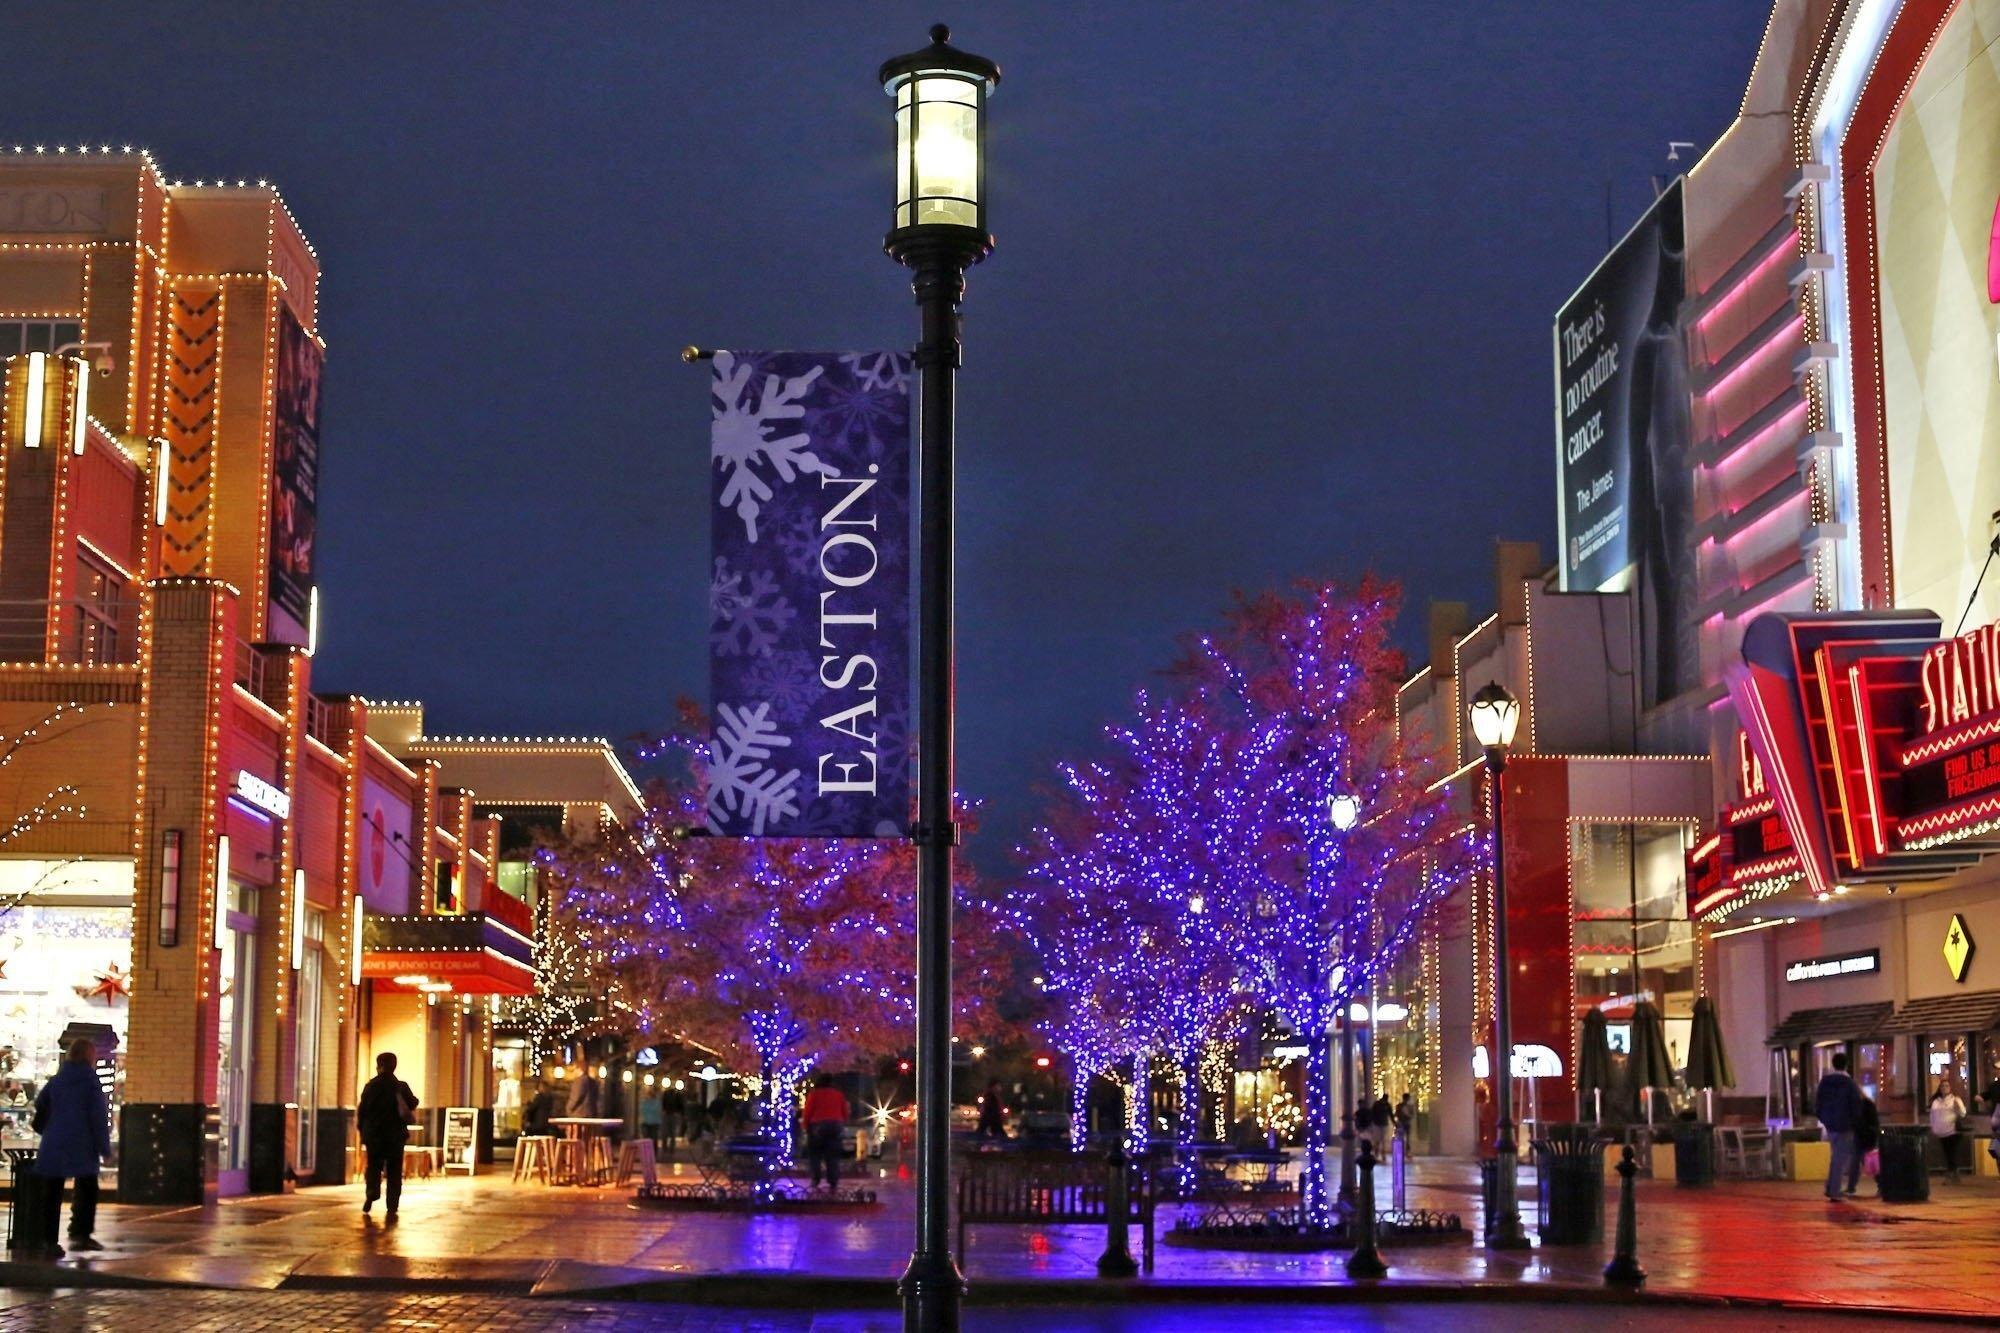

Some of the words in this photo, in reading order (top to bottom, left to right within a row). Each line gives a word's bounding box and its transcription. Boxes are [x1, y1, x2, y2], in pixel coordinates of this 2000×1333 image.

[1563, 316, 1594, 368] There
[1595, 299, 1606, 337] is
[1566, 382, 1580, 418] no
[1581, 342, 1619, 403] routine
[1568, 410, 1604, 465] cancer.
[1577, 489, 1590, 513] The
[1591, 470, 1614, 503] James
[818, 463, 878, 797] EASTON.
[1971, 749, 1985, 770] US
